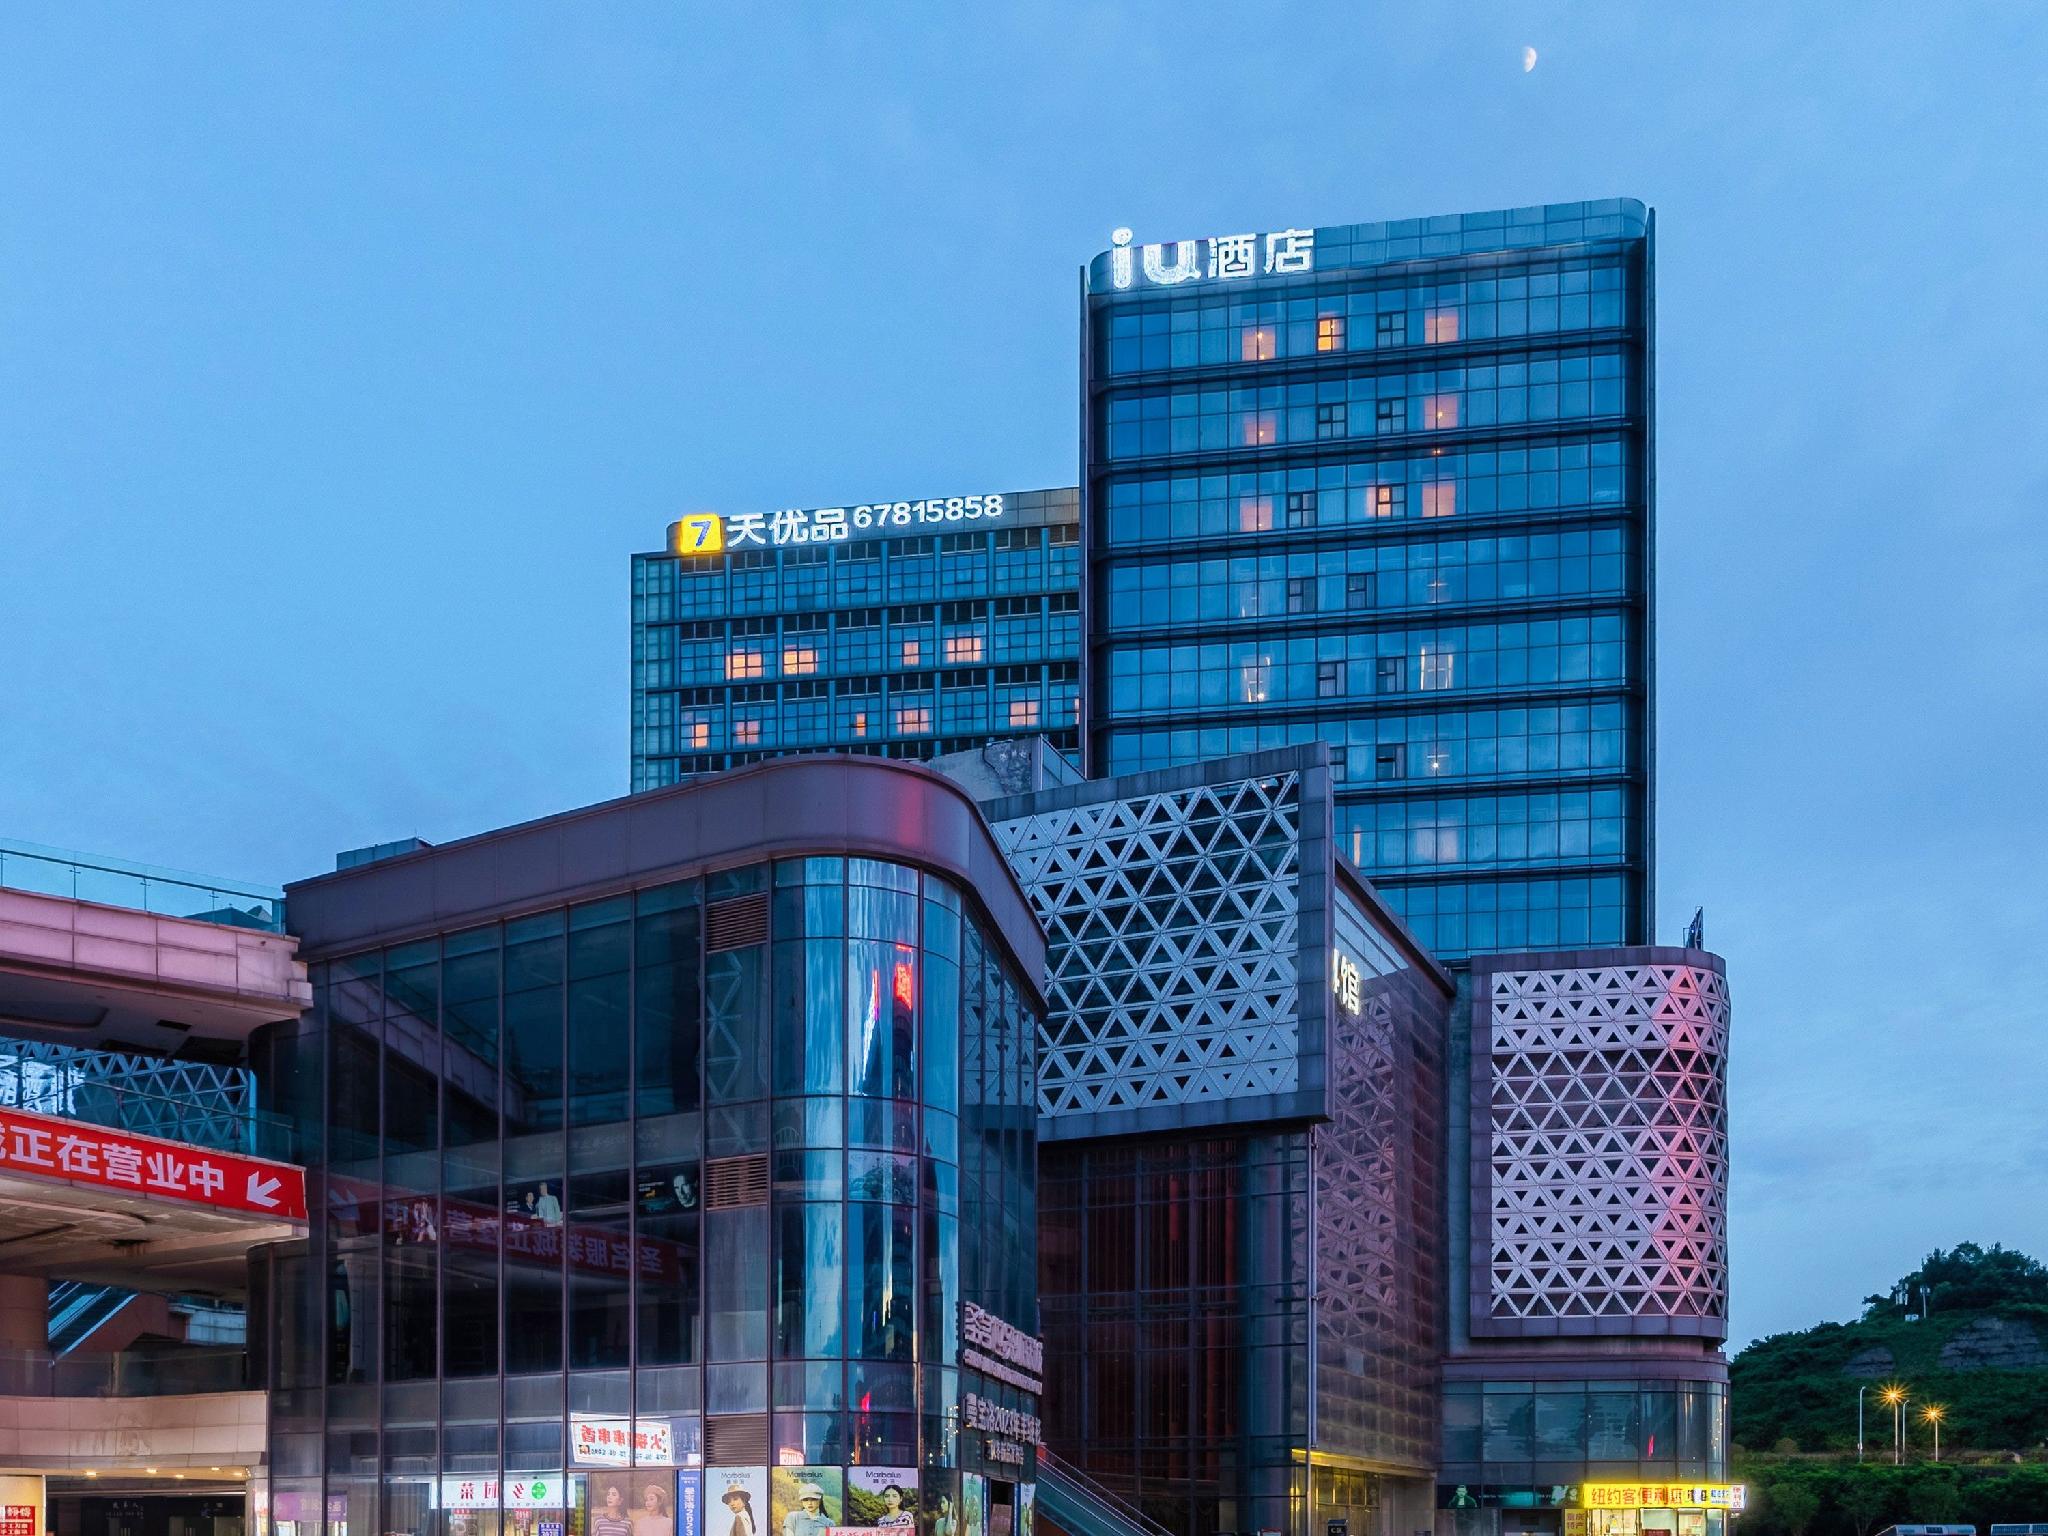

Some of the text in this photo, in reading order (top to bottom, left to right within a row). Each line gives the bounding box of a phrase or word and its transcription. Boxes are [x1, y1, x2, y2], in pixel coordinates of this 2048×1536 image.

[852, 494, 1004, 530] 67815858
[0, 1122, 225, 1199] 正在营业中
[1591, 1487, 1683, 1506] 纽约客便利店
